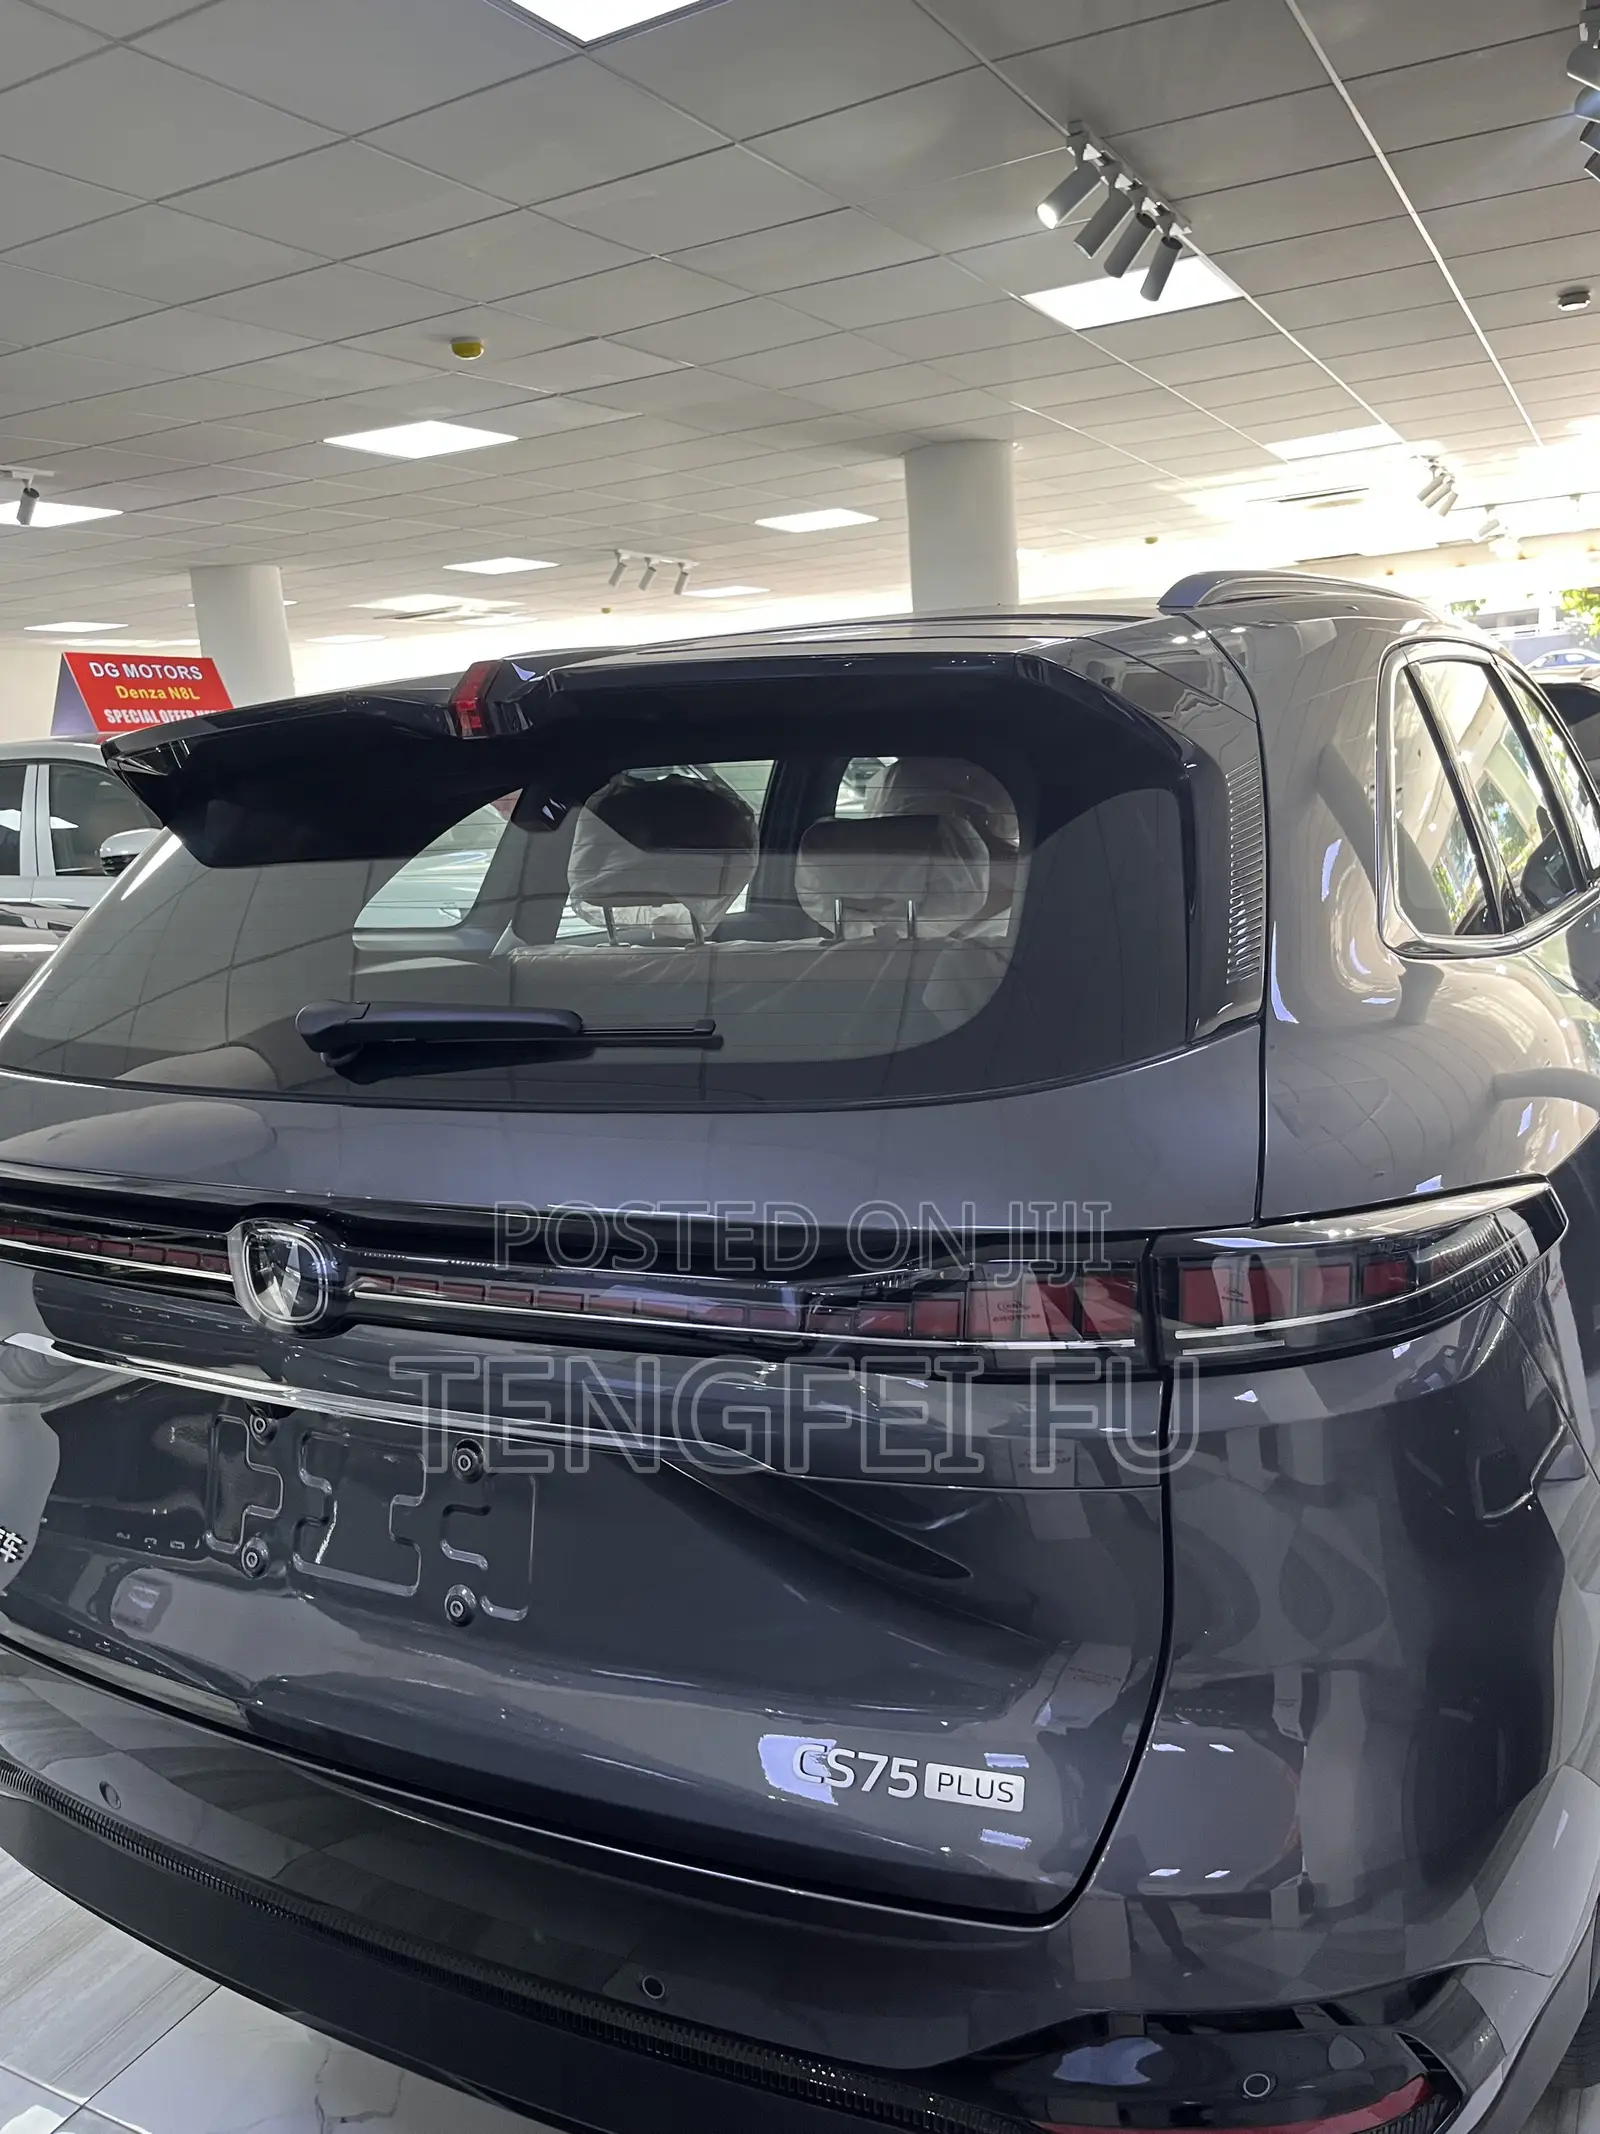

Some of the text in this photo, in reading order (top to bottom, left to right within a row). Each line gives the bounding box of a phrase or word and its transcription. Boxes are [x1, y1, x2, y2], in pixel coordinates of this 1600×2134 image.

[89, 661, 203, 681] DG MOTORS
[116, 685, 200, 701] Denza N8L
[104, 708, 161, 725] SPECIAL
[0, 1527, 23, 1562] 车
[792, 1743, 1014, 1804] CS75 PLUS
